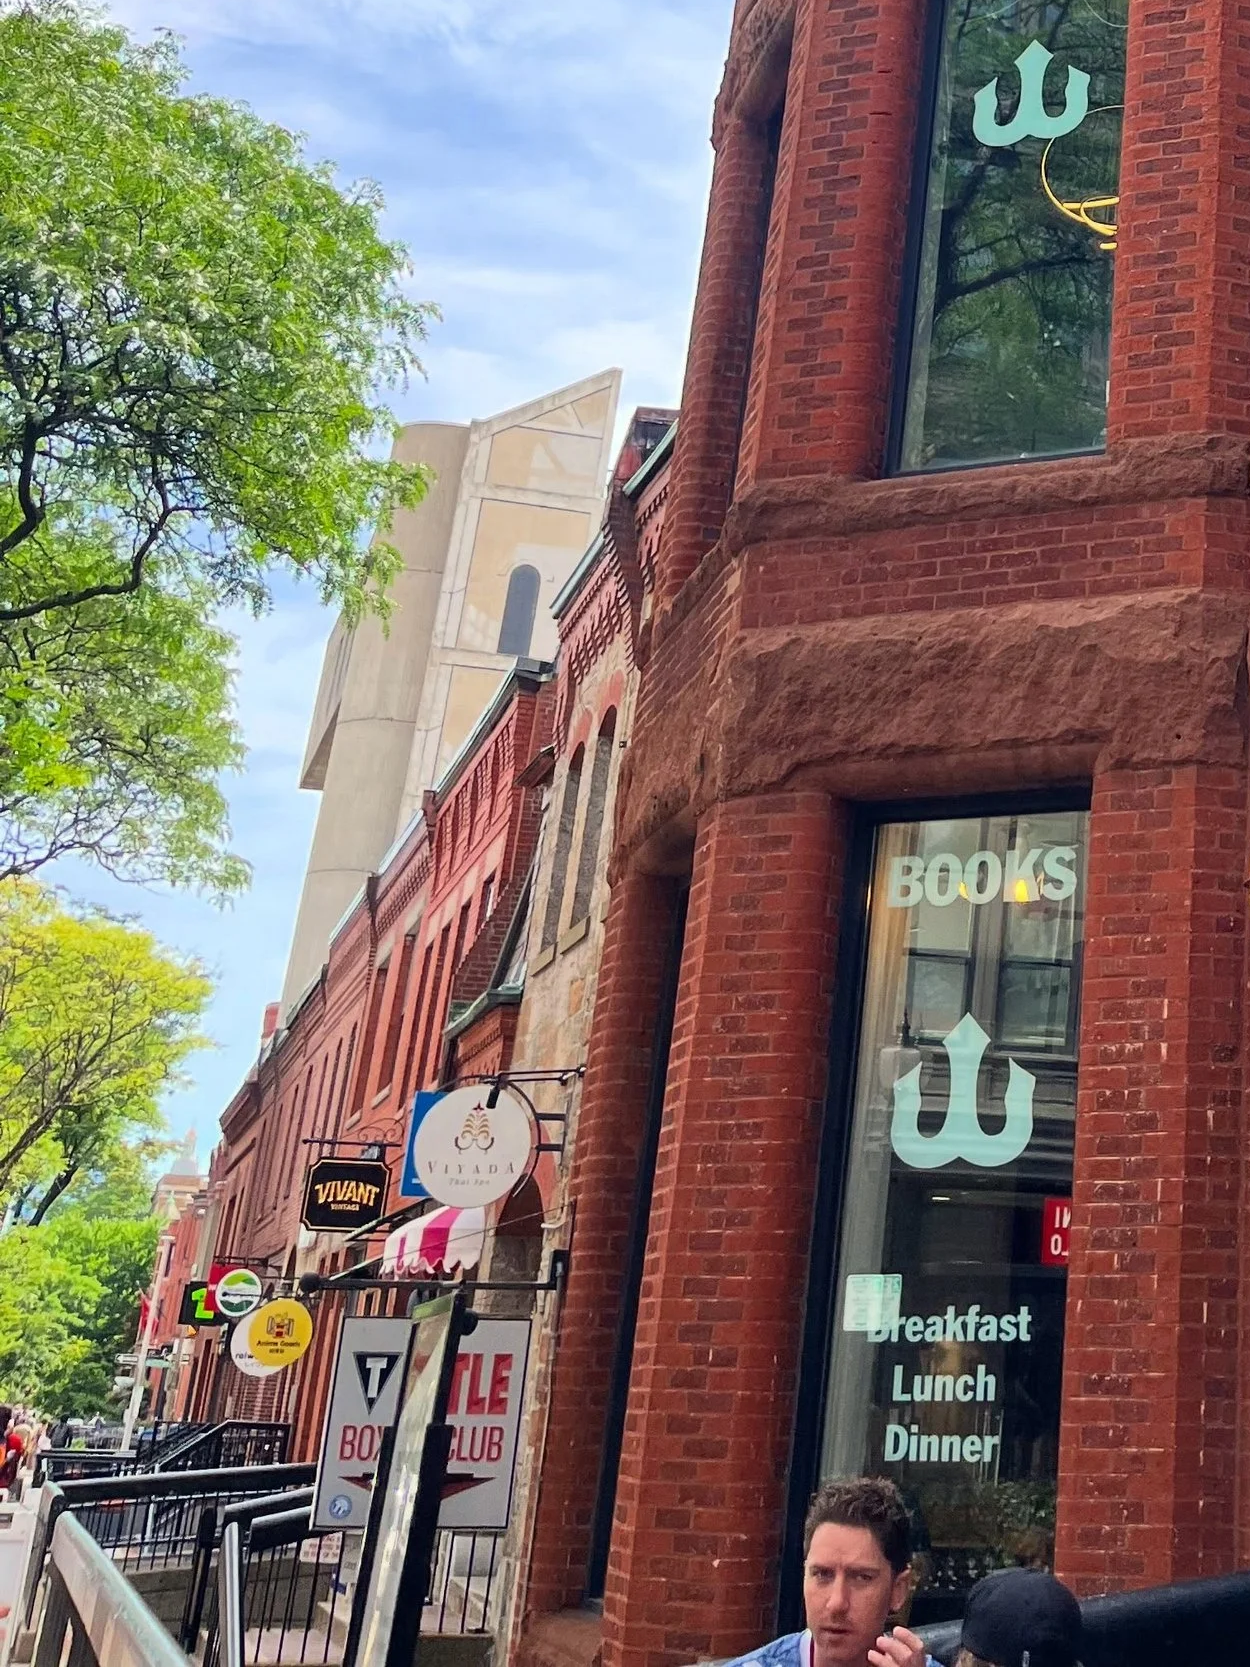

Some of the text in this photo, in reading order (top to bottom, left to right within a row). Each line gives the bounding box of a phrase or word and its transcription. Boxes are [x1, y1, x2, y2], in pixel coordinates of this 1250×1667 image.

[887, 846, 1077, 908] BOOKS
[427, 1161, 515, 1175] VIYADA
[314, 1180, 380, 1207] VIVANT
[892, 1364, 996, 1402] Lunch
[884, 1423, 1000, 1462] Dinner
